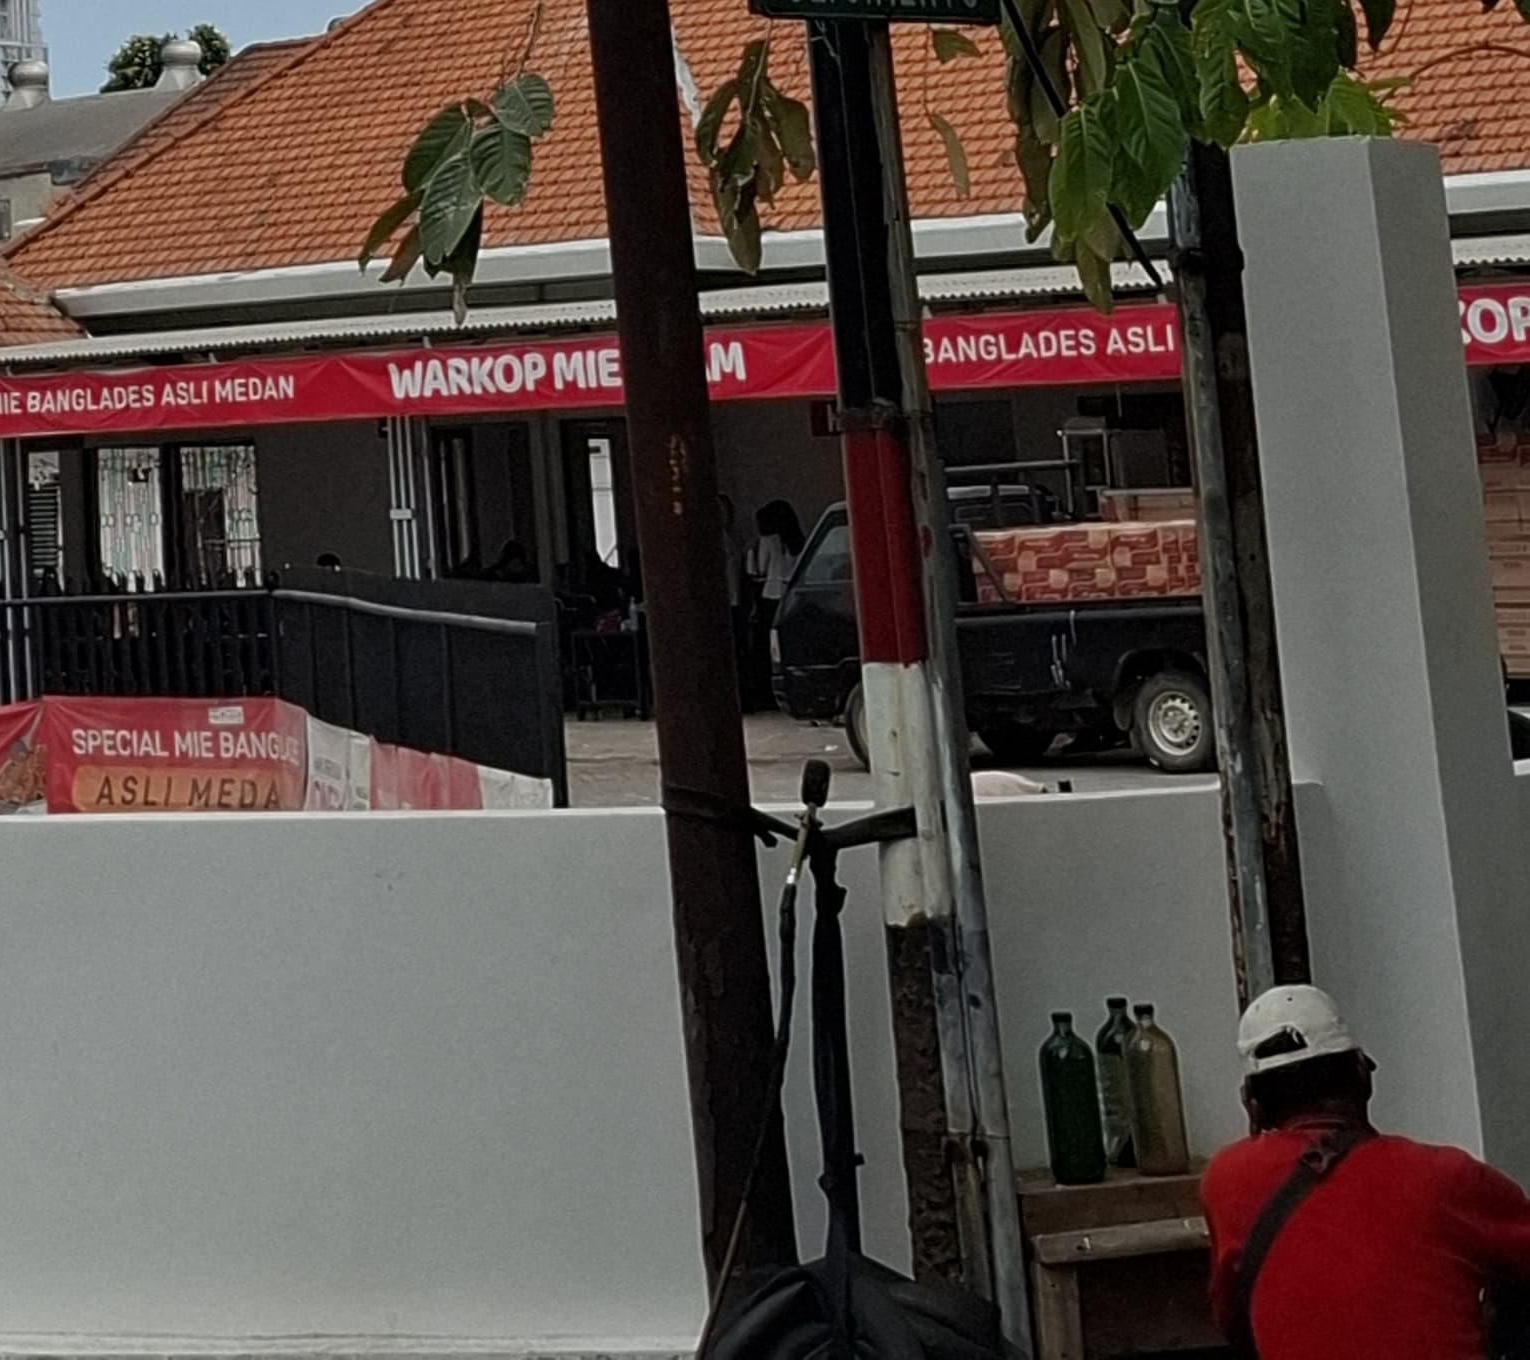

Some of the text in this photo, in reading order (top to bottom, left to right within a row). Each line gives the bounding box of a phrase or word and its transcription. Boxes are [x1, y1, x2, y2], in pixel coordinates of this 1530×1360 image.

[1106, 323, 1175, 356] ASLI
[387, 347, 624, 400] WARKOP MIE
[26, 384, 155, 414] BANGLADES
[161, 378, 208, 407] ASLI
[214, 374, 295, 404] MEDAN
[71, 728, 169, 757] SPECIAL
[173, 730, 215, 759] MIE
[94, 775, 173, 808] ASLI
